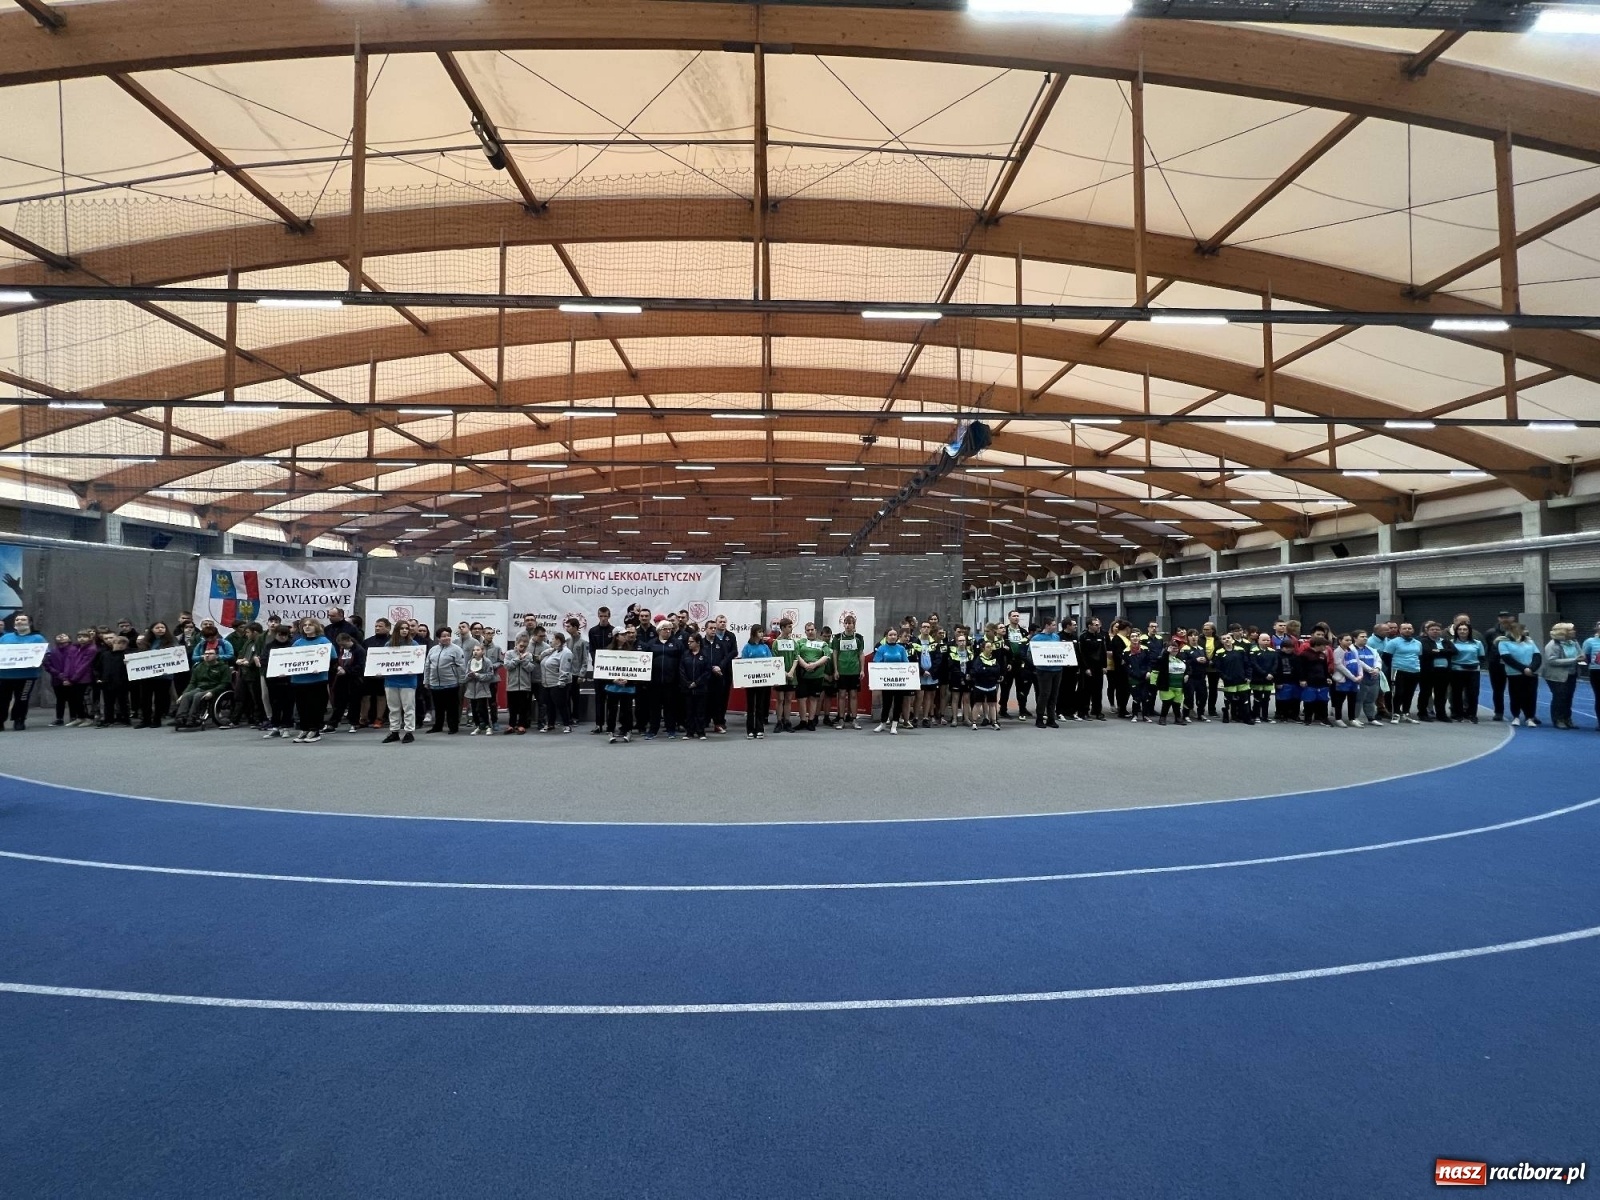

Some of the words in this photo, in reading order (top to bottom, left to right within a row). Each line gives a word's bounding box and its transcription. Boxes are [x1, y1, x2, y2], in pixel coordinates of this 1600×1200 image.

[528, 568, 563, 581] ŚLĄSKI
[566, 570, 605, 580] MITYNG
[608, 571, 702, 582] LEKKOATLETYCZNY
[265, 577, 350, 589] STAROSTWO
[562, 584, 608, 596] Olimpiad
[611, 585, 670, 597] Specjalnych
[266, 594, 351, 605] POWIATOWE
[729, 621, 752, 633] Śląski
